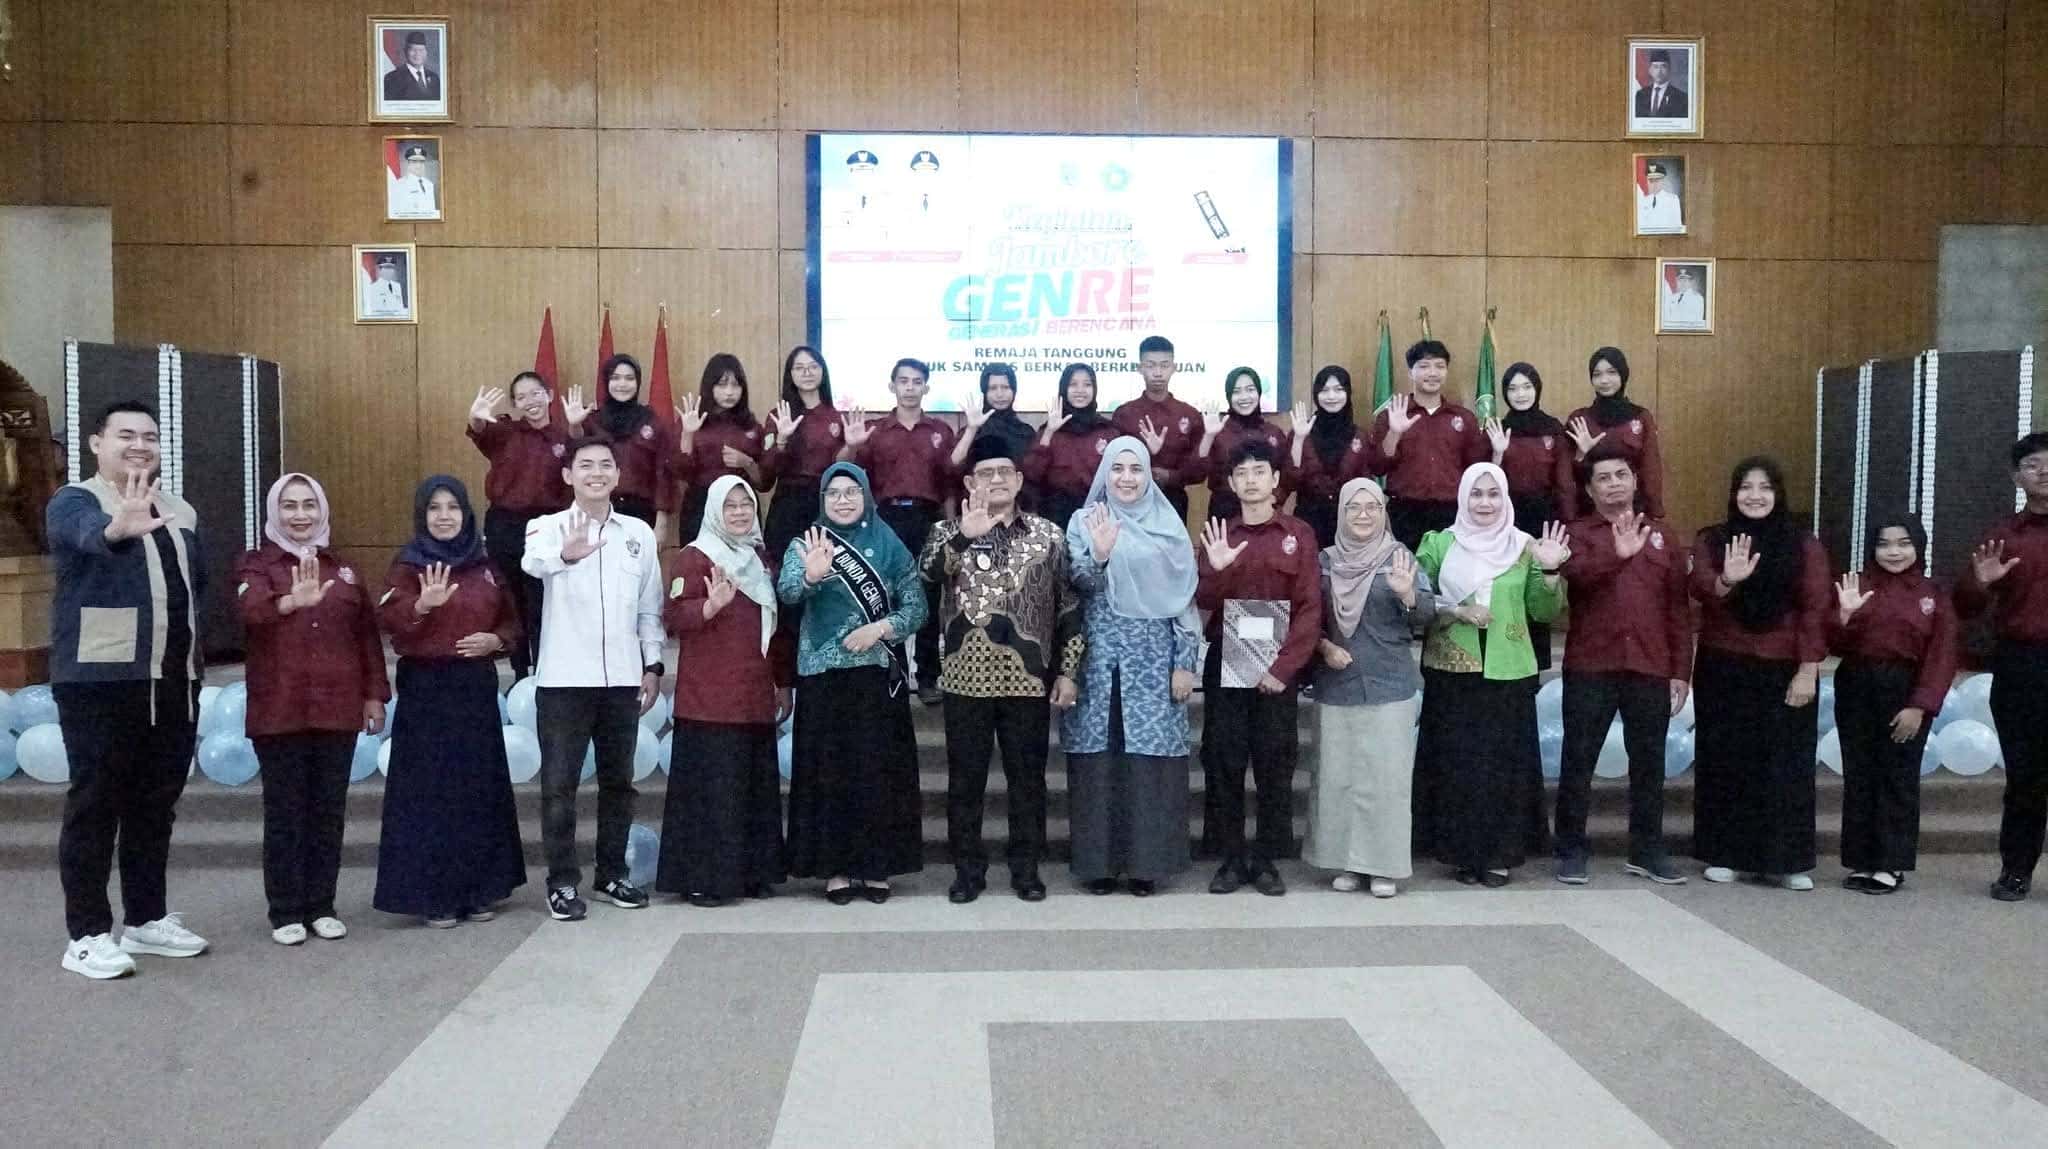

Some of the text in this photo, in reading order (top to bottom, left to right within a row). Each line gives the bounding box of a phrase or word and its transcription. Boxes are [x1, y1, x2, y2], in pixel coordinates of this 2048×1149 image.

[941, 265, 1155, 322] GENRE
[1045, 314, 1158, 336] BERENCANA
[974, 347, 1127, 358] REMAJA TANGGUNG
[835, 552, 868, 585] BUNDA
